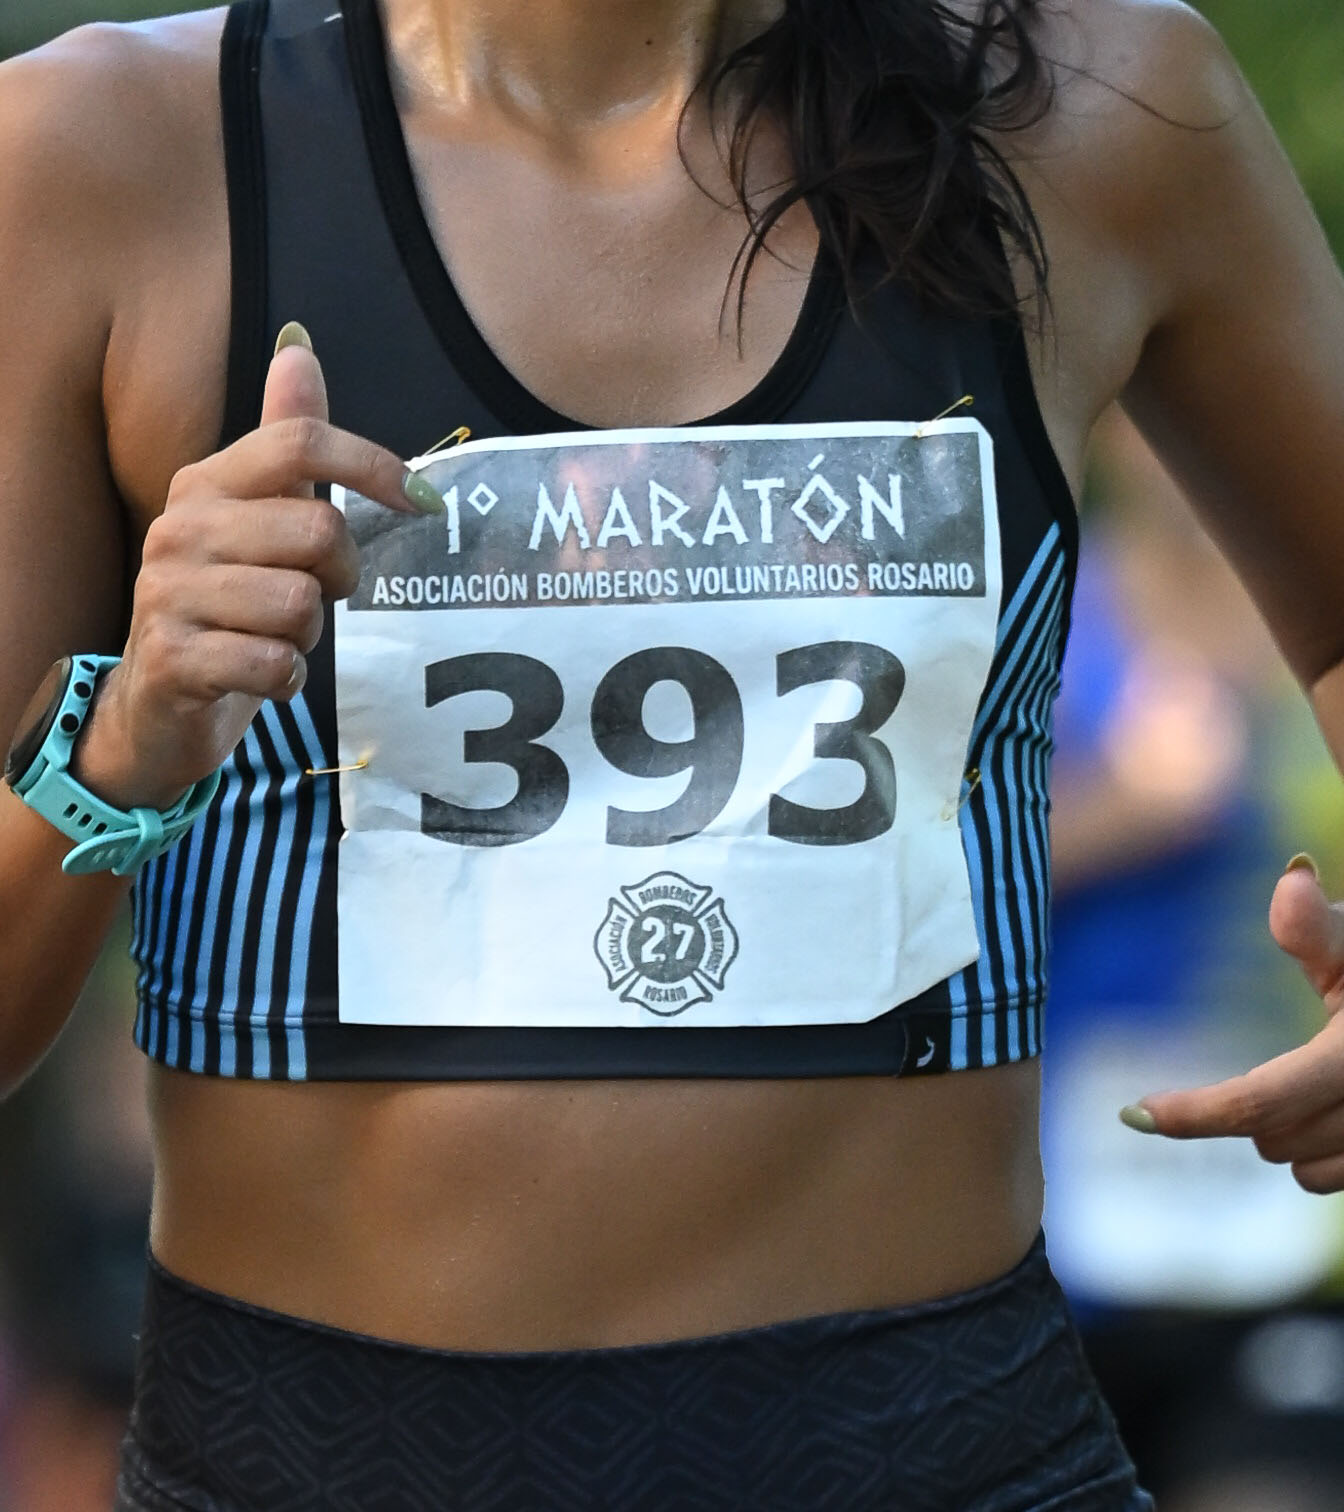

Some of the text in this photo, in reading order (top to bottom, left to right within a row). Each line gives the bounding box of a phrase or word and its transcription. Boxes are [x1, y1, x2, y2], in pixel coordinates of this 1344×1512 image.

[526, 453, 906, 551] MARATÓN
[371, 561, 976, 605] ASOCIACIÓN BOMBEROS VOLUNTARIOS ROSARIO
[420, 640, 906, 848] 393
[640, 916, 695, 964] 27
